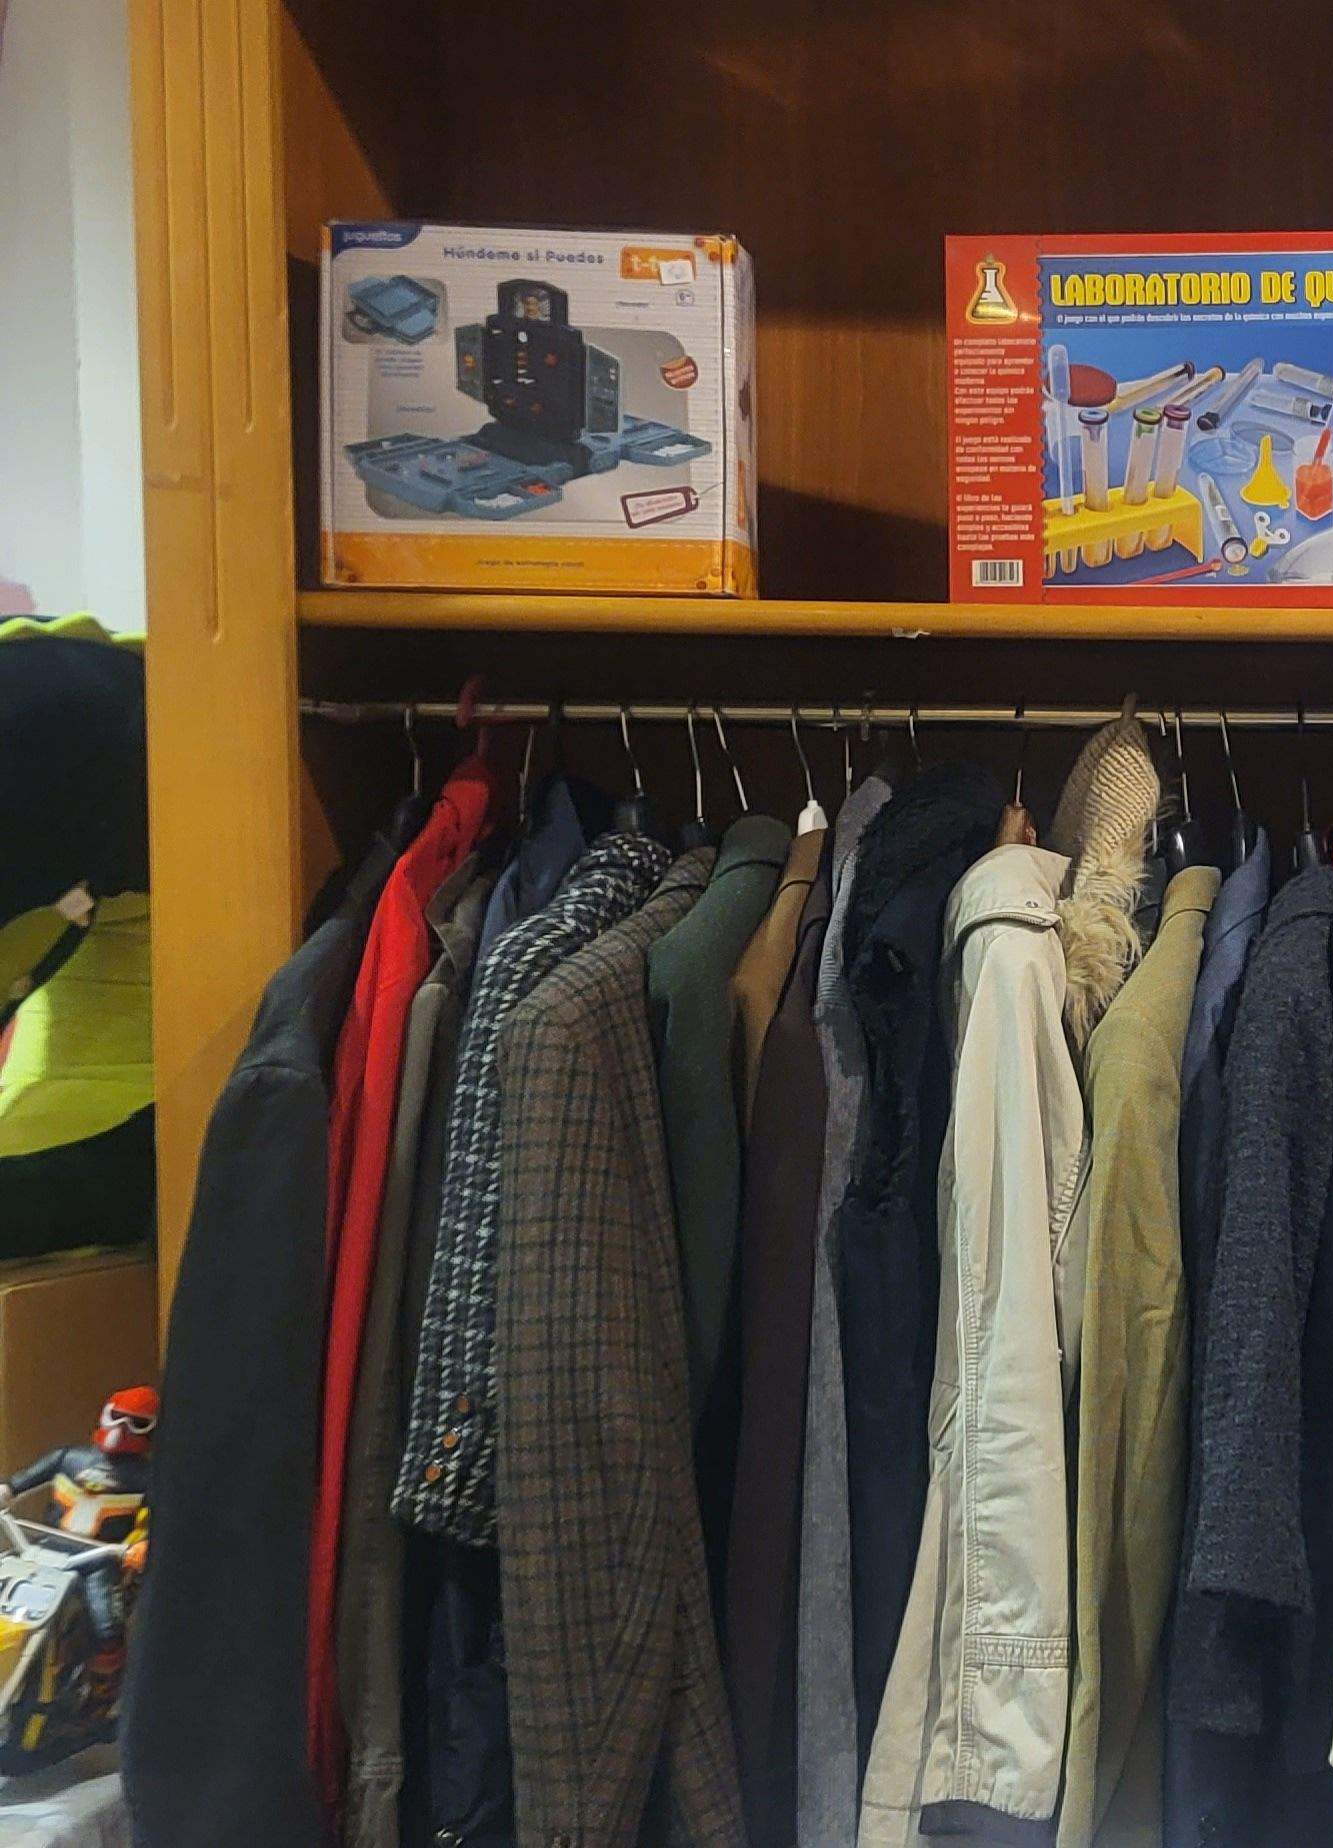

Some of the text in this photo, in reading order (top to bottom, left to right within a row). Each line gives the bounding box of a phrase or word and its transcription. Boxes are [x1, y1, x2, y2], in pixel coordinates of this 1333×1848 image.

[443, 247, 605, 265] Húndeme si Puedes
[1050, 272, 1251, 307] LABORATORIO
[1260, 271, 1296, 304] DE
